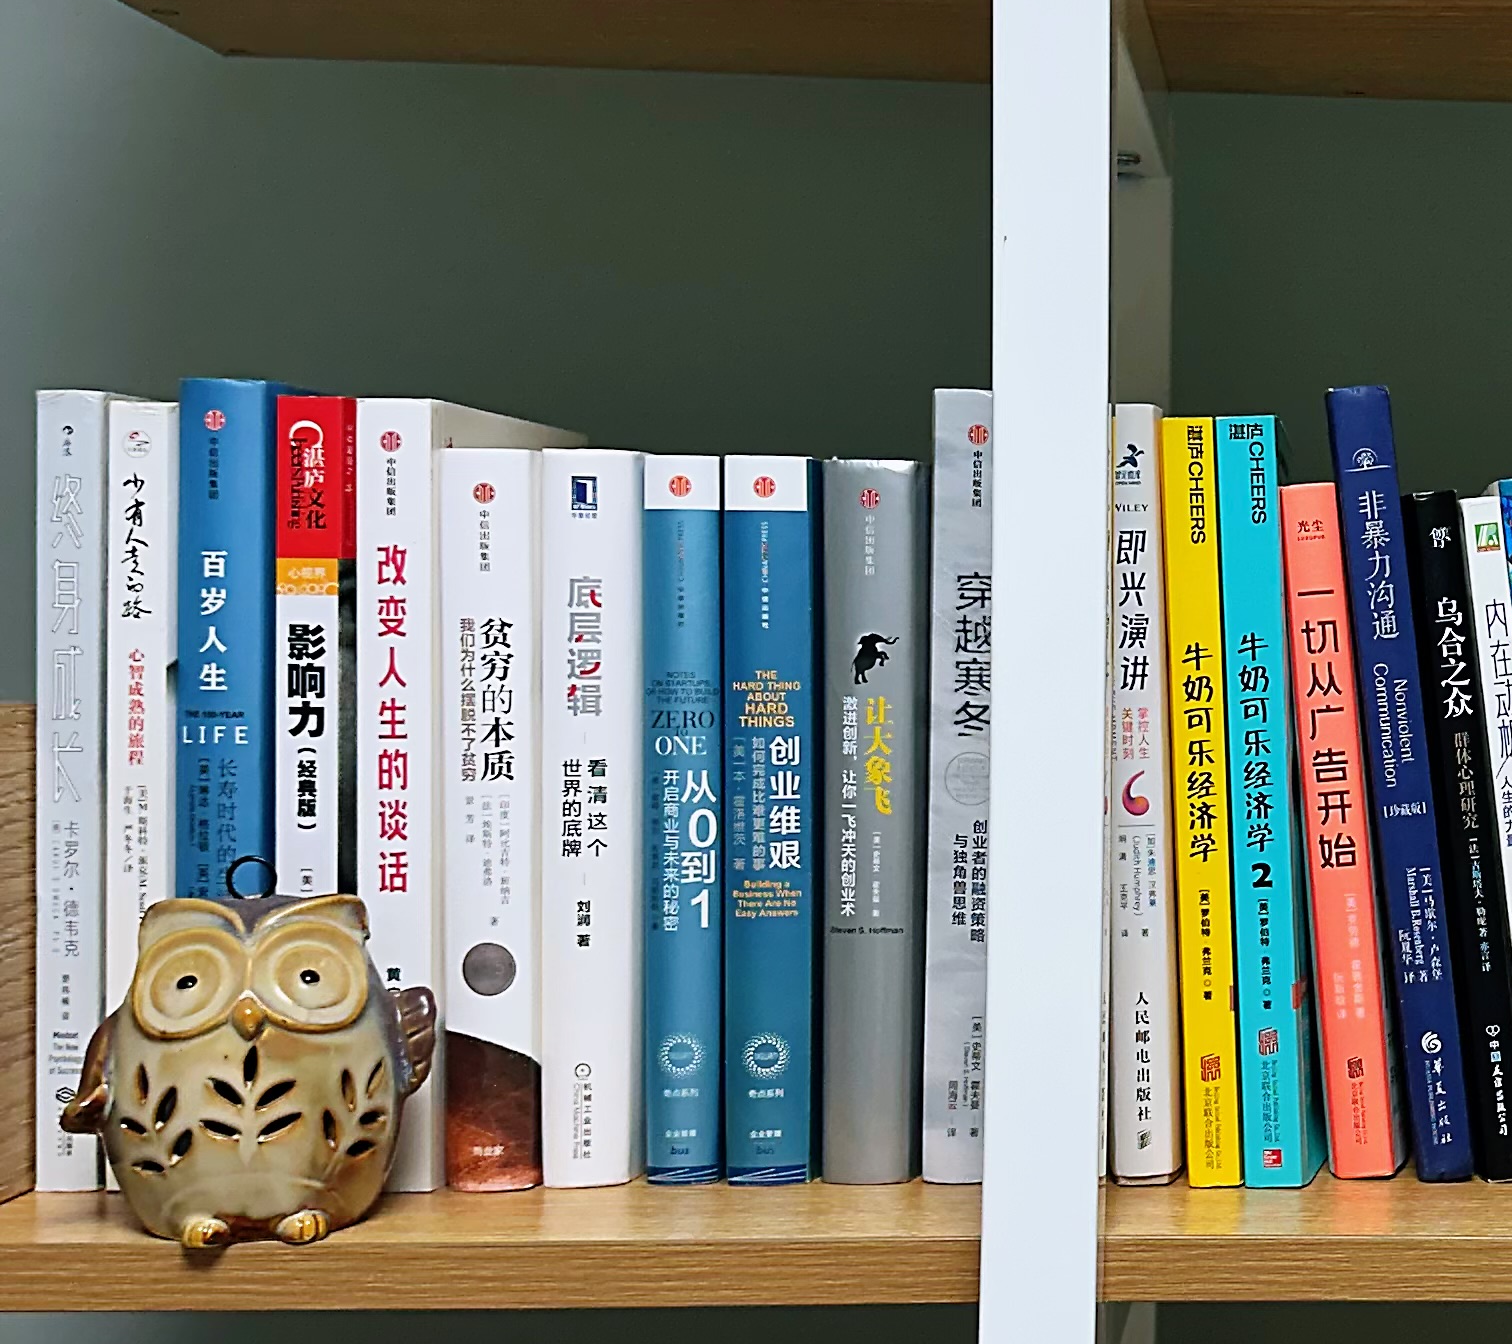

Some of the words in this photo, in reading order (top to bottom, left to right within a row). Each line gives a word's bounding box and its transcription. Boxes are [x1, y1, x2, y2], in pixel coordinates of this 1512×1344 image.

[1248, 442, 1267, 525] CHEERS
[120, 471, 152, 620] 少有人走的路
[1358, 489, 1400, 642] 非暴力沟通
[50, 473, 84, 804] 终身成长
[199, 550, 229, 693] 百岁人生
[566, 575, 602, 718] 底层逻辑
[953, 571, 991, 737] 穿越寒冬
[1115, 529, 1150, 692] 即兴演讲
[1434, 597, 1474, 720] 乌合之众
[127, 648, 145, 767] 心智成熟的旅程
[183, 725, 249, 746] LIFE
[287, 623, 327, 738] 影响力
[377, 544, 409, 895] 改变人生的谈话
[460, 617, 477, 782] 我们为什么摆脱不了贫穷
[479, 617, 515, 782] 贫穷的本质
[651, 710, 714, 729] ZERO
[732, 681, 764, 691] HARD
[767, 681, 801, 692] THING
[738, 715, 795, 728] THINGS
[744, 702, 788, 715] HARD
[746, 691, 787, 702] ABOUT
[755, 669, 778, 680] THE
[1296, 588, 1357, 870] 一切从广告开始
[1372, 662, 1397, 788] Communication
[1394, 678, 1416, 764] Nonviolent
[655, 735, 707, 756] ONE
[768, 735, 801, 870] 创业维艰
[864, 696, 893, 815] 让大象飞
[1181, 642, 1219, 862] 牛奶可乐经济学
[562, 758, 583, 858] 世界的底牌
[587, 758, 608, 857] 看清这个
[663, 769, 680, 931] 开启商业与未来的秘密
[681, 769, 718, 930] 从0到1
[576, 899, 591, 927] 刘润
[951, 834, 968, 926] 与独角兽思维
[970, 819, 988, 943] 创业者的融资策略
[1135, 991, 1152, 1121] 人民邮电出版社
